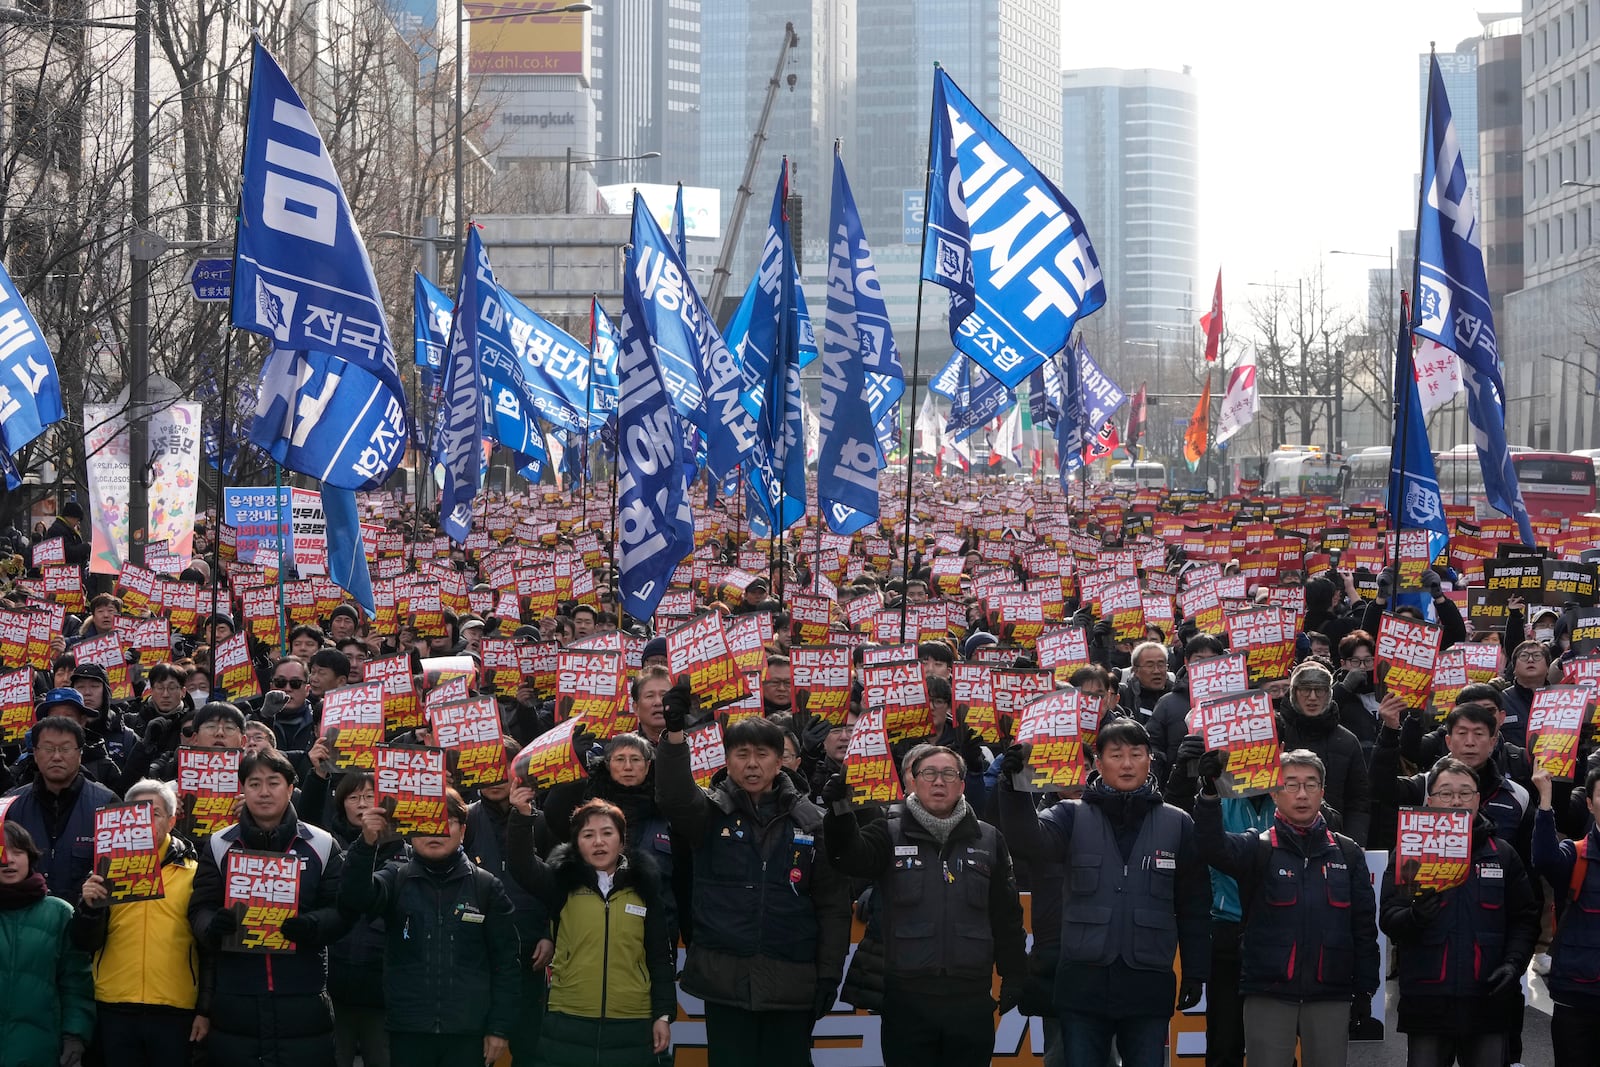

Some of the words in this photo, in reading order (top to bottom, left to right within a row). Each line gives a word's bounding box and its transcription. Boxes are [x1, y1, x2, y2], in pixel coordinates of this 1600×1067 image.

[502, 112, 574, 128] Heungkuk
[45, 565, 79, 578] 내란수괴
[122, 562, 155, 582] 내란수괴
[515, 562, 554, 582] 내란수괴
[1399, 561, 1428, 574] 탄핵!
[1524, 567, 1538, 575] 규탄
[45, 578, 81, 592] 윤석열
[119, 575, 153, 595] 윤석열
[164, 583, 195, 594] 내란수괴
[518, 578, 555, 594] 윤석열
[1100, 579, 1138, 600] 내란수괴
[1183, 581, 1215, 604] 내란수괴
[1488, 577, 1519, 589] 윤석열
[1521, 576, 1541, 588] 퇴진
[1546, 580, 1576, 592] 윤석열
[1578, 583, 1592, 595] 퇴진
[164, 594, 196, 608] 윤석열
[792, 598, 829, 609] 내란수괴
[848, 592, 881, 610] 내란수괴
[1000, 594, 1041, 607] 내란수괴
[1101, 592, 1140, 615] 윤석열
[1471, 606, 1502, 616] 윤석열
[792, 608, 829, 623] 윤석열
[1003, 607, 1042, 621] 윤석열
[1112, 610, 1142, 626] 탄핵!
[1196, 609, 1221, 626] 탄핵!
[1230, 609, 1280, 628] 내란수괴
[669, 611, 720, 652] 내란수괴
[800, 624, 828, 635] 탄핵!
[1012, 624, 1043, 637] 탄핵!
[1039, 628, 1086, 651] 내란수괴
[1115, 626, 1143, 641] 구속!
[1232, 626, 1282, 647] 윤석열
[1381, 618, 1441, 646] 내란수괴
[76, 634, 119, 656] 내란수괴
[517, 642, 558, 658] 내란수괴
[671, 632, 726, 674] 윤석열
[865, 645, 915, 665] 내란수괴
[1041, 643, 1087, 665] 윤석열
[1247, 646, 1282, 665] 탄핵!
[1378, 637, 1435, 669] 윤석열
[365, 654, 408, 678] 내란수괴
[559, 653, 619, 673] 내란수괴
[792, 648, 848, 666] 내란수괴
[1192, 655, 1244, 679] 내란수괴
[222, 665, 252, 683] 탄핵!
[690, 659, 733, 694] 탄핵!
[794, 668, 849, 686] 윤석열
[866, 663, 922, 686] 내란수괴
[992, 671, 1053, 691] 내란수괴
[1249, 665, 1284, 682] 구속!
[1384, 667, 1431, 690] 탄핵!
[559, 673, 616, 696] 윤석열
[699, 679, 743, 709] 구속!
[1192, 674, 1245, 698] 윤석열
[325, 683, 382, 708] 내란수괴
[806, 691, 848, 709] 탄핵!
[868, 683, 926, 708] 윤석열
[1022, 689, 1077, 720] 내란수괴
[1533, 690, 1588, 707] 내란수괴
[2, 709, 32, 725] 탄핵!
[324, 704, 382, 727] 윤석열
[434, 698, 496, 725] 내란수괴
[569, 699, 616, 718] 탄핵!
[1205, 692, 1269, 724] 내란수괴
[386, 714, 422, 731] 구속!
[886, 709, 928, 729] 탄핵!
[1018, 713, 1078, 744] 윤석열
[1529, 708, 1581, 732] 윤석열
[334, 728, 382, 748] 탄핵!
[438, 718, 499, 748] 윤석열
[888, 724, 932, 744] 구속!
[1208, 717, 1274, 748] 윤석열
[1028, 742, 1080, 765] 탄핵!
[1532, 734, 1577, 753] 탄핵!
[180, 750, 240, 770] 내란수괴
[378, 750, 443, 771] 내란수괴
[457, 744, 502, 769] 탄핵!
[528, 743, 570, 775] 탄핵!
[1226, 745, 1276, 772] 탄핵!
[180, 772, 239, 793] 윤석열
[461, 765, 506, 787] 구속!
[538, 765, 580, 789] 구속!
[846, 760, 891, 784] 탄핵!
[1032, 766, 1082, 788] 구속!
[1232, 768, 1279, 793] 구속!
[378, 770, 443, 796] 윤석열
[852, 783, 897, 804] 구속!
[96, 802, 152, 830] 내란수괴
[392, 800, 443, 818] 탄핵!
[396, 820, 447, 835] 구속!
[1400, 812, 1469, 833] 내란수괴
[96, 826, 154, 853] 윤석열
[1400, 833, 1468, 858] 윤석열
[107, 855, 154, 879] 탄핵!
[230, 856, 298, 879] 내란수괴
[1414, 863, 1468, 881] 탄핵!
[111, 877, 158, 900] 구속!
[230, 876, 295, 904] 윤석열
[242, 906, 294, 927] 탄핵!
